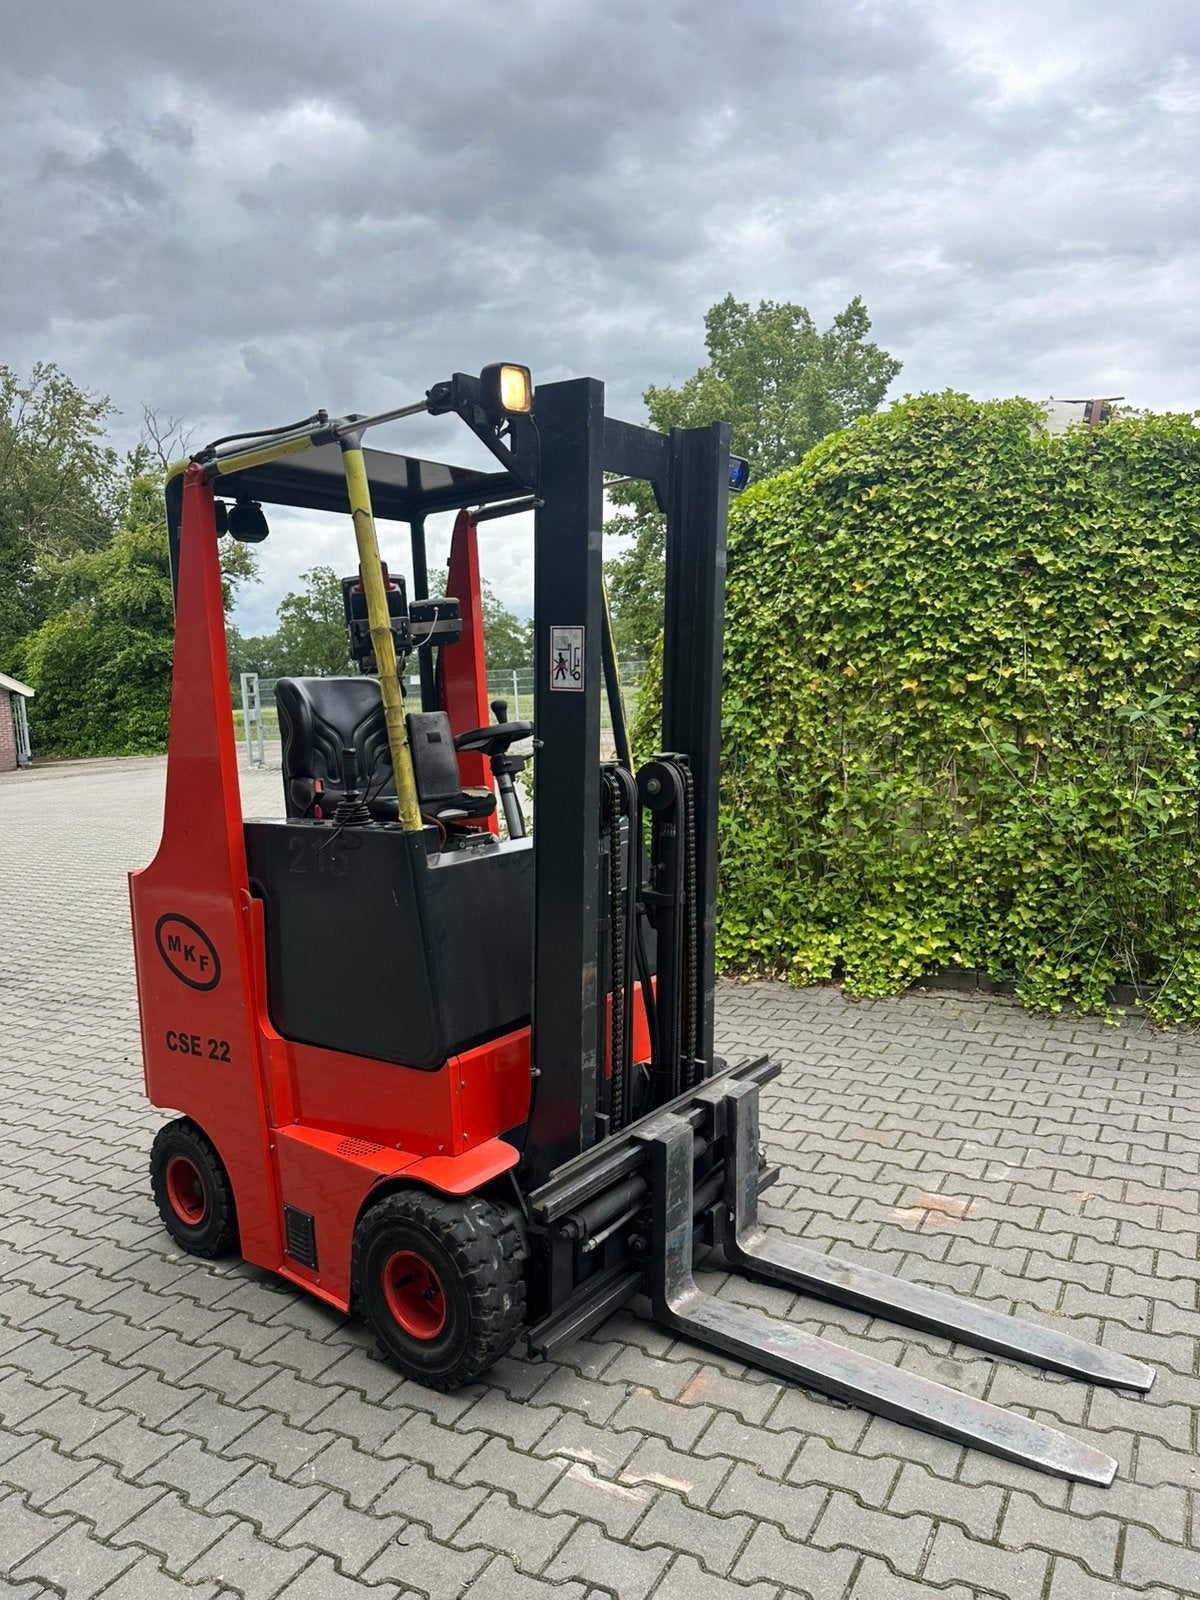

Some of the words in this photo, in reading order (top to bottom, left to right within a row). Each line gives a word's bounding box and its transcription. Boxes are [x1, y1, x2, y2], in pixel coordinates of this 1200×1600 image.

[167, 934, 209, 972] MKF
[165, 1030, 203, 1057] CSE
[207, 1038, 232, 1063] 22
